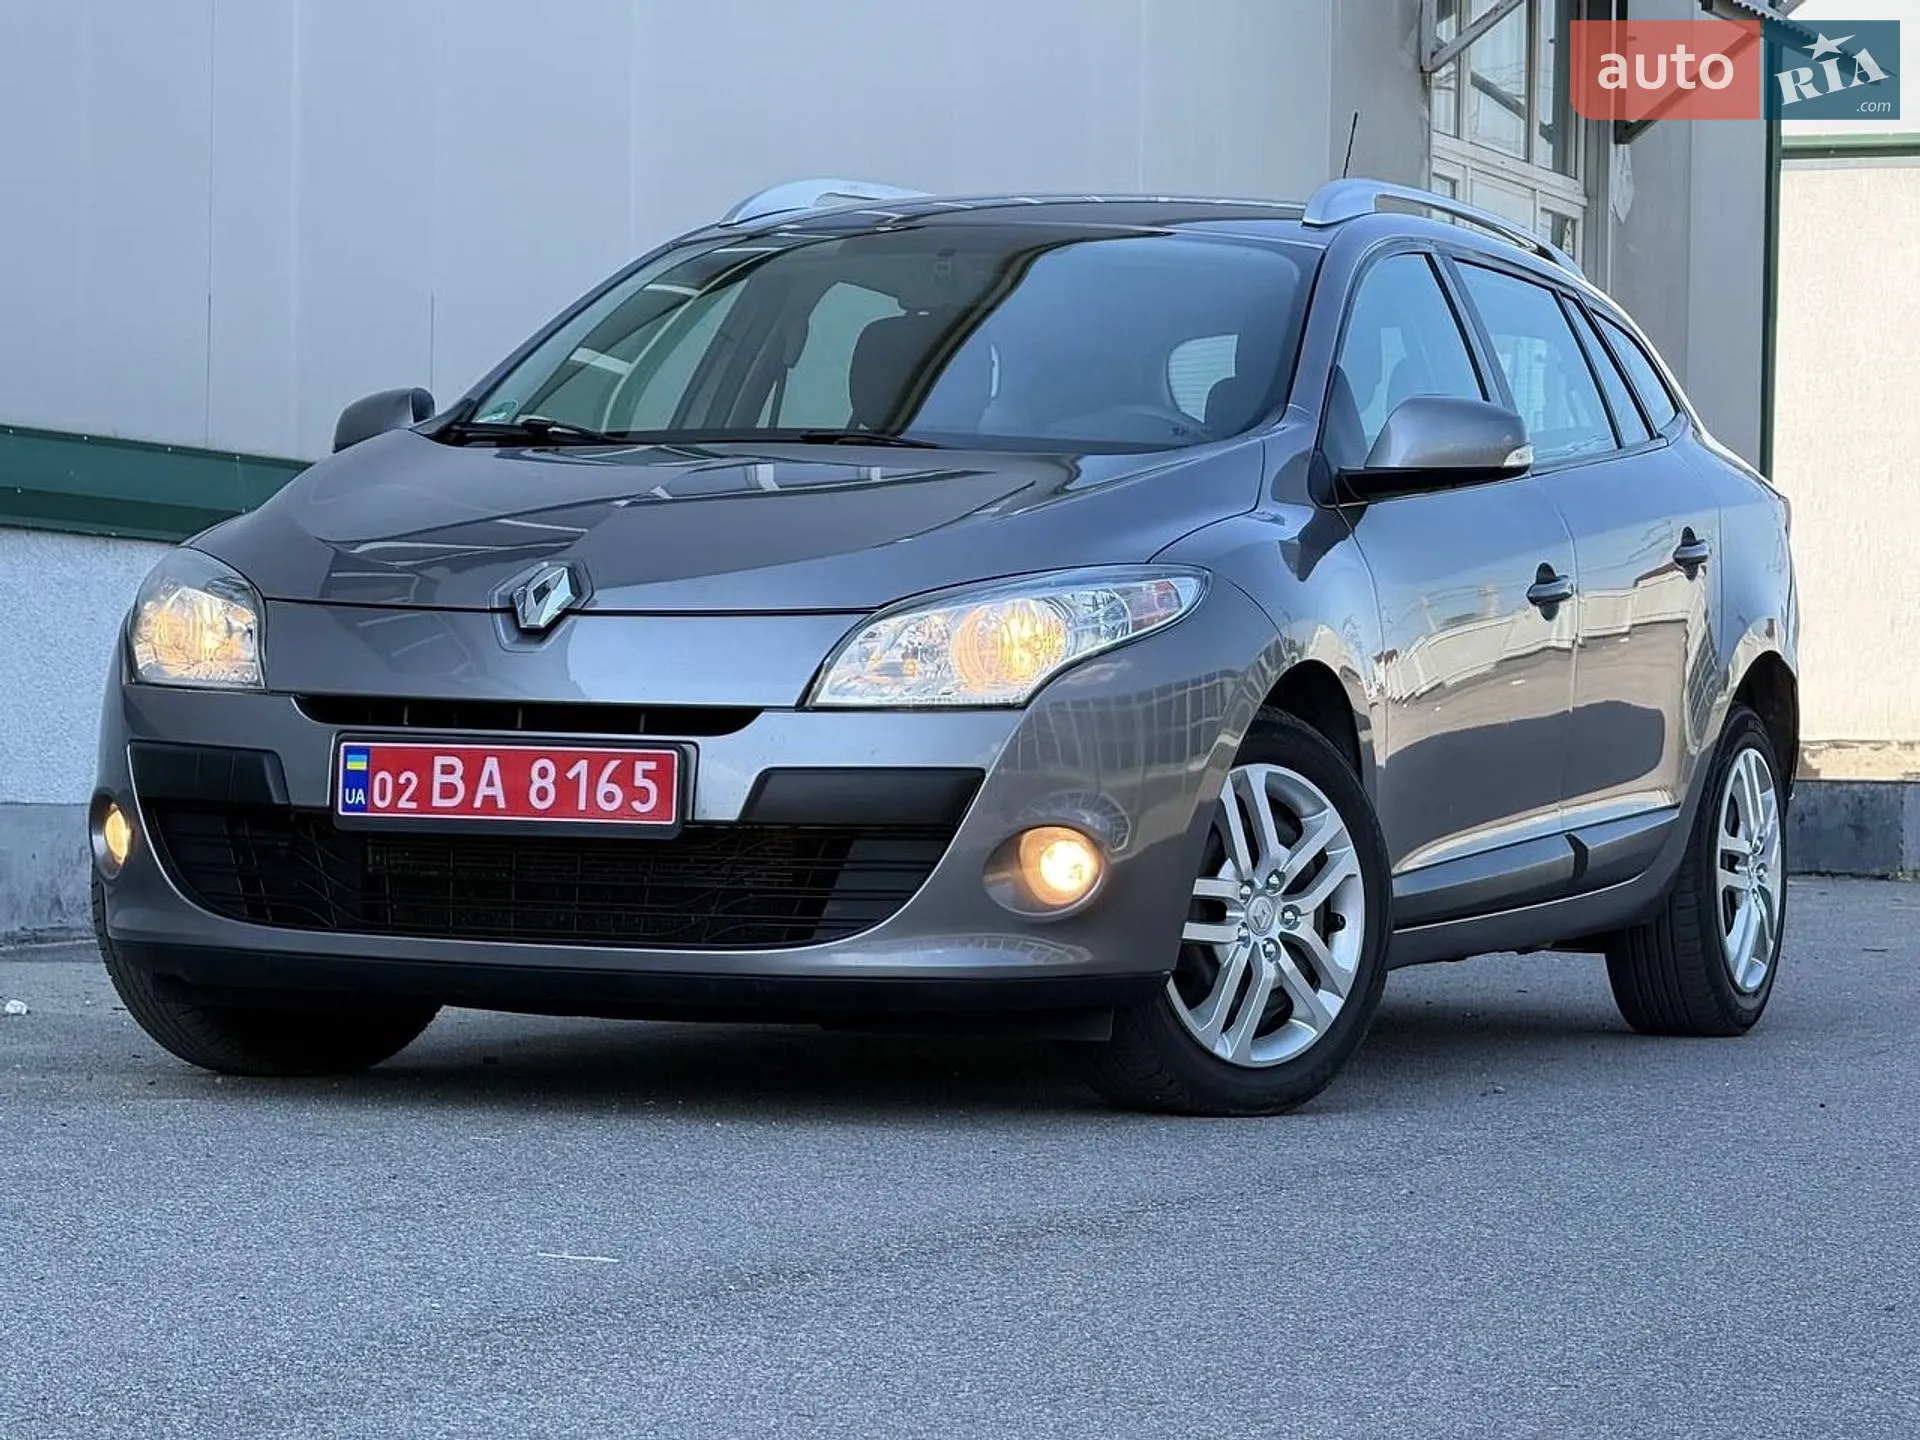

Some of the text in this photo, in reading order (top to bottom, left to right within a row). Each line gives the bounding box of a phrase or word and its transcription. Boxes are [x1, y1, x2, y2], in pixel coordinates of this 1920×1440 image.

[345, 790, 366, 805] UA
[373, 755, 658, 814] 02 BA 8165
